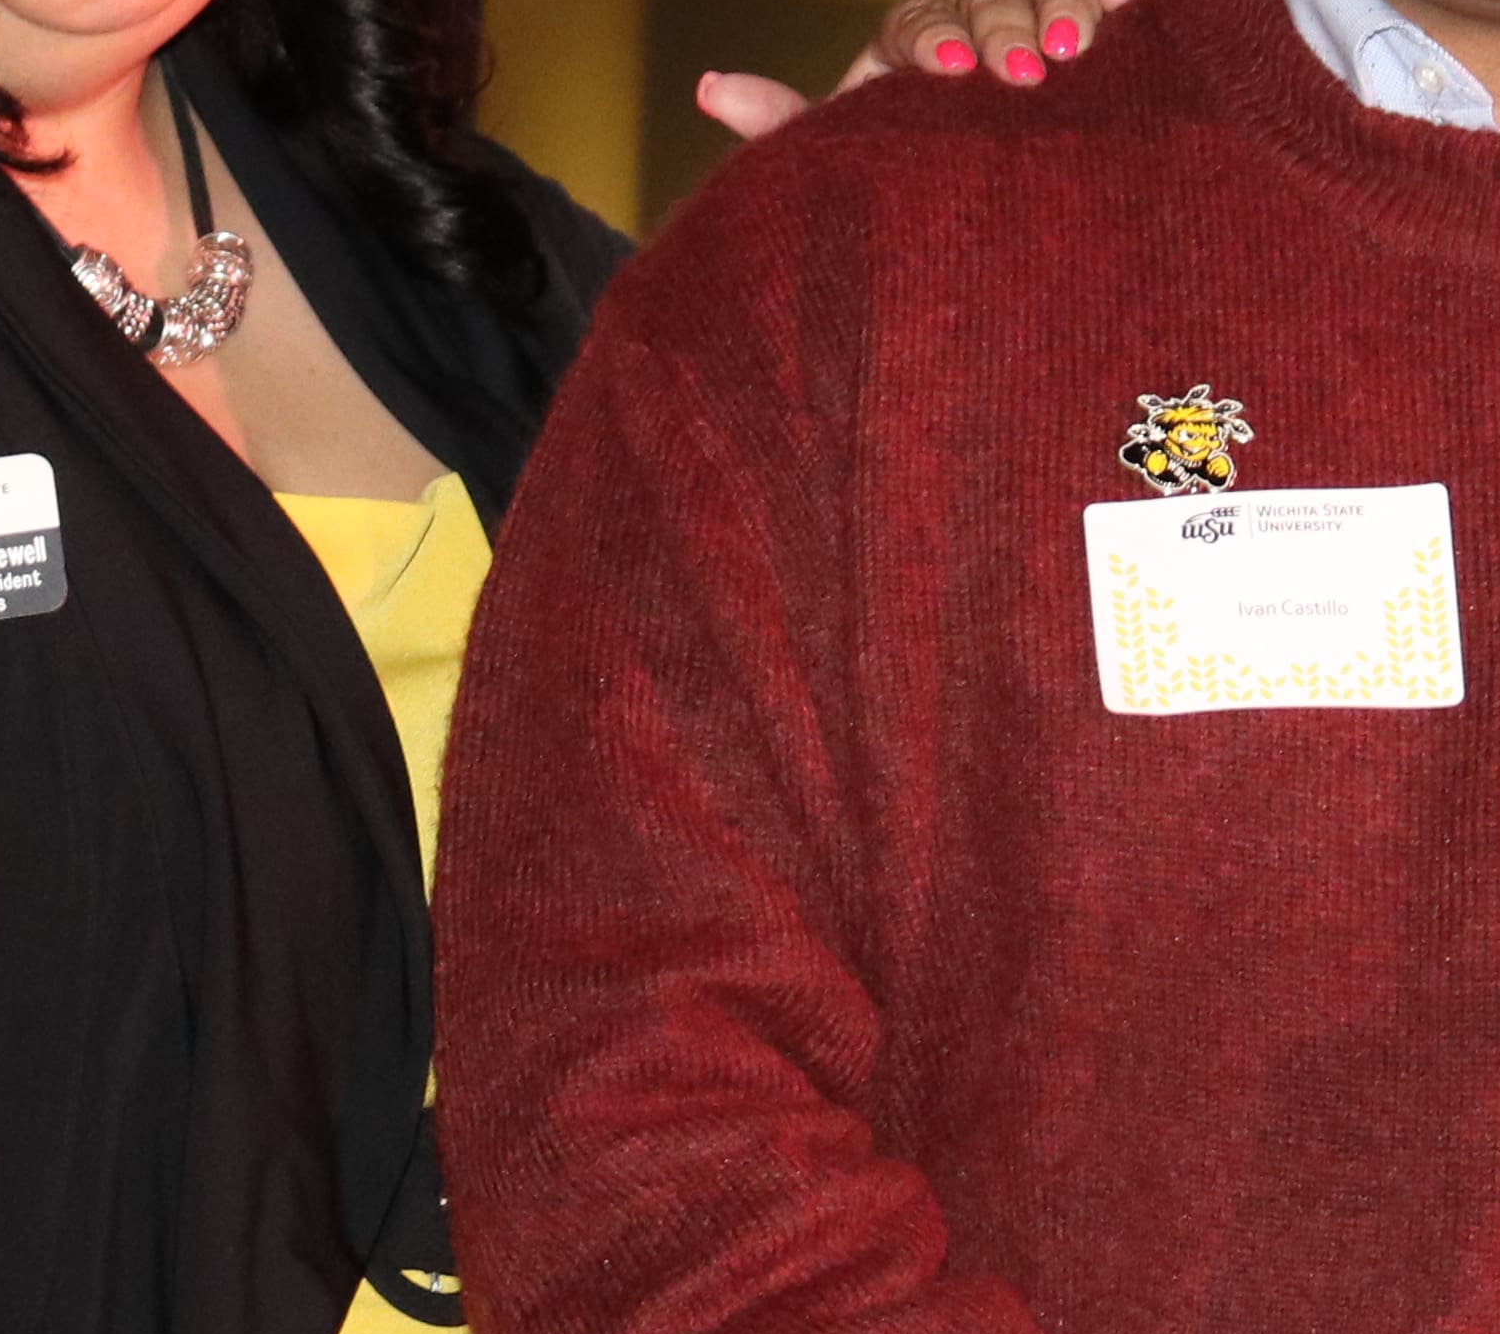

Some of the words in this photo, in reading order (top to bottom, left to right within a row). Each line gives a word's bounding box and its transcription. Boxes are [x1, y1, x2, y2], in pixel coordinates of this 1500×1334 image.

[1256, 504, 1319, 518] WICHITA
[1323, 503, 1365, 516] STATE
[1257, 519, 1343, 533] UNIVERSITY
[1237, 600, 1278, 618] Ivan
[1280, 599, 1350, 618] Castillo
